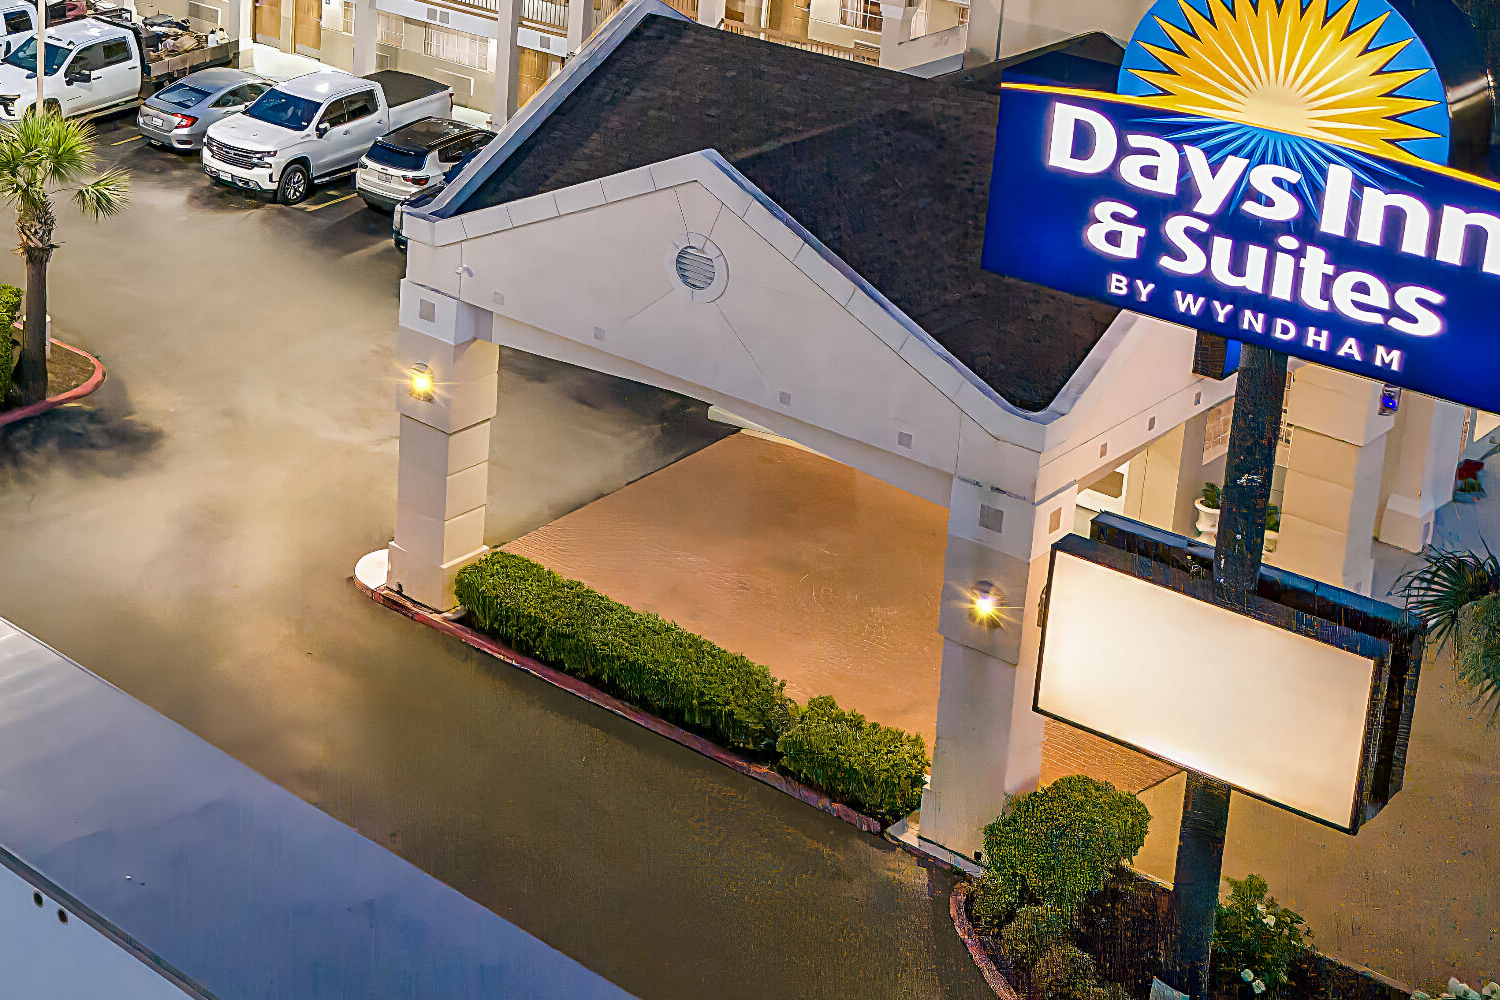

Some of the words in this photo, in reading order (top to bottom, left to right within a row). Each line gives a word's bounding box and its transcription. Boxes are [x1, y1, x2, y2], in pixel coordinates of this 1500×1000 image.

[1047, 101, 1303, 221] Days
[1319, 162, 1500, 275] Inn
[1086, 200, 1147, 260] &
[1157, 214, 1447, 337] Suites
[1109, 273, 1156, 303] BY
[1174, 290, 1404, 372] WYNDHAM
